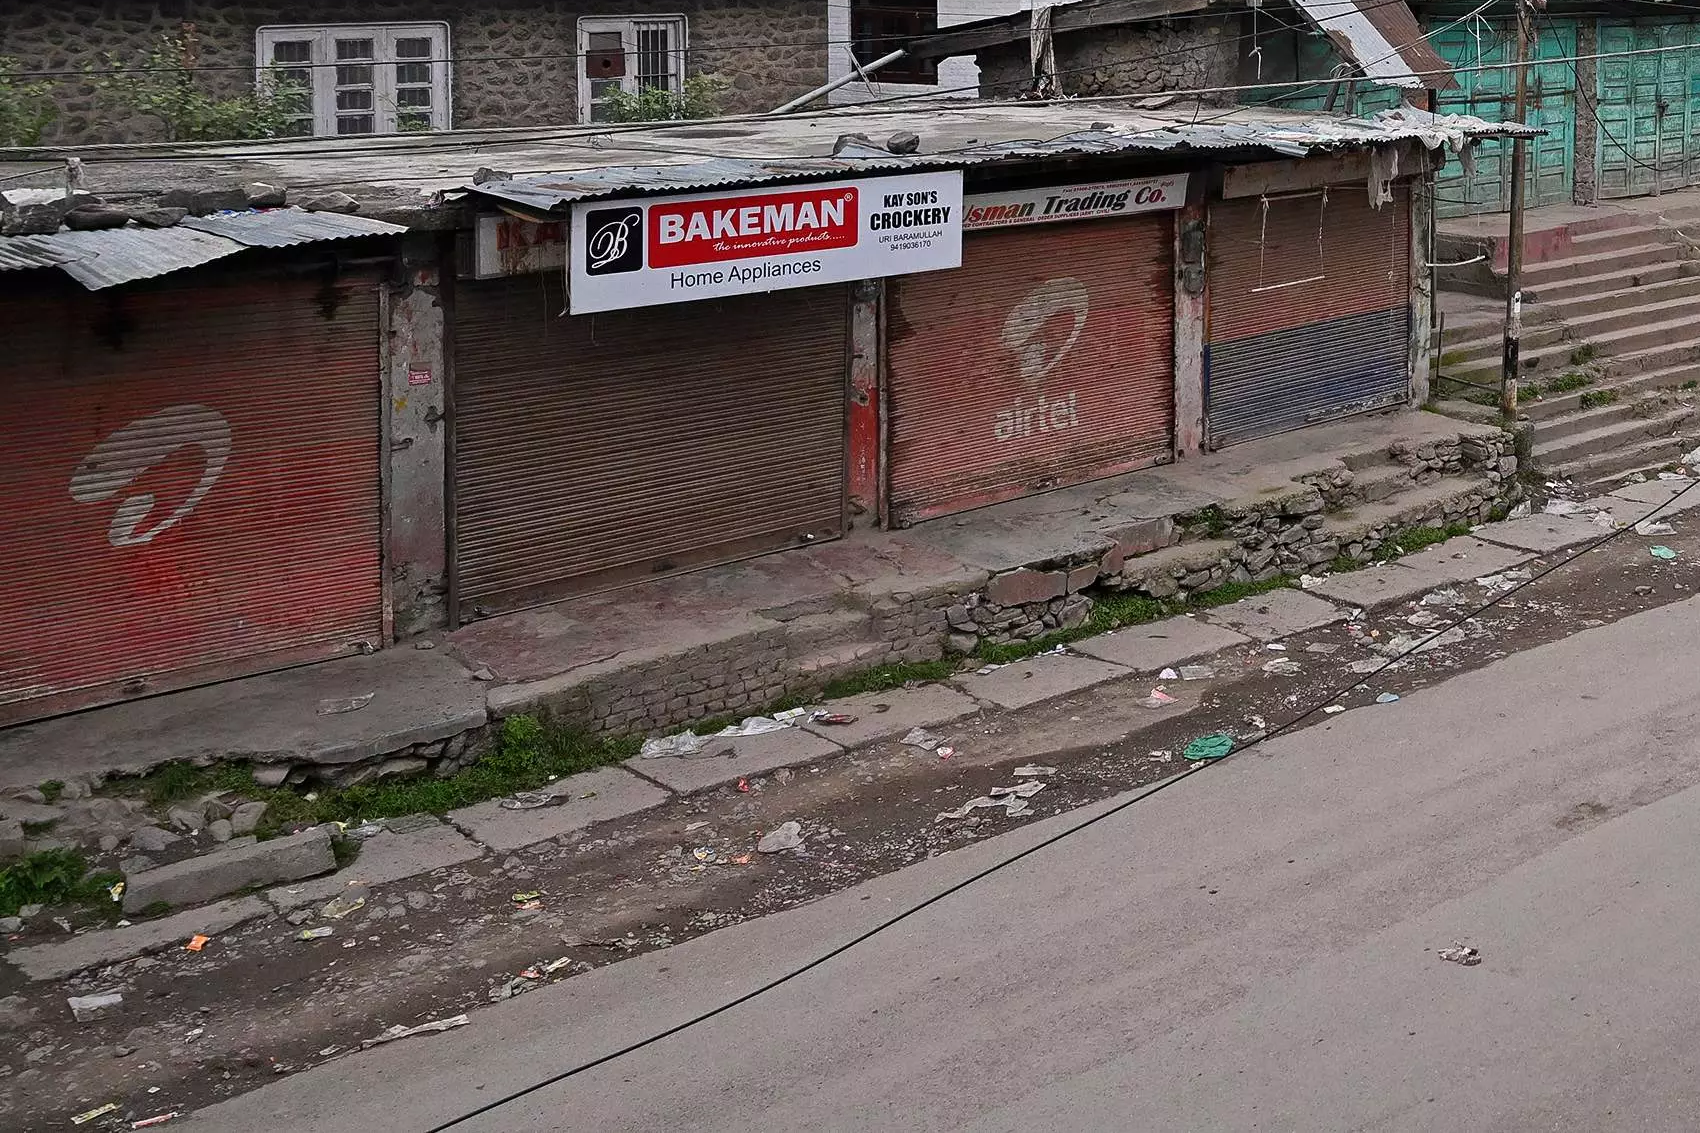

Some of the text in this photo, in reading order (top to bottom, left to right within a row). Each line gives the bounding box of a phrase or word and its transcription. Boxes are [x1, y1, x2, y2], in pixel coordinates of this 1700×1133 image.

[884, 190, 938, 208] KAY SON'S
[1043, 189, 1131, 215] Trading
[1134, 186, 1167, 205] Co.
[659, 198, 845, 245] BAKEMAN
[870, 206, 951, 231] CROCKERY
[712, 241, 731, 252] the
[733, 236, 787, 250] innovative
[879, 230, 943, 244] URI BARAMULLAH
[890, 240, 932, 251] 9419036170
[670, 259, 822, 289] Home Appliances
[994, 391, 1079, 441] airtel
